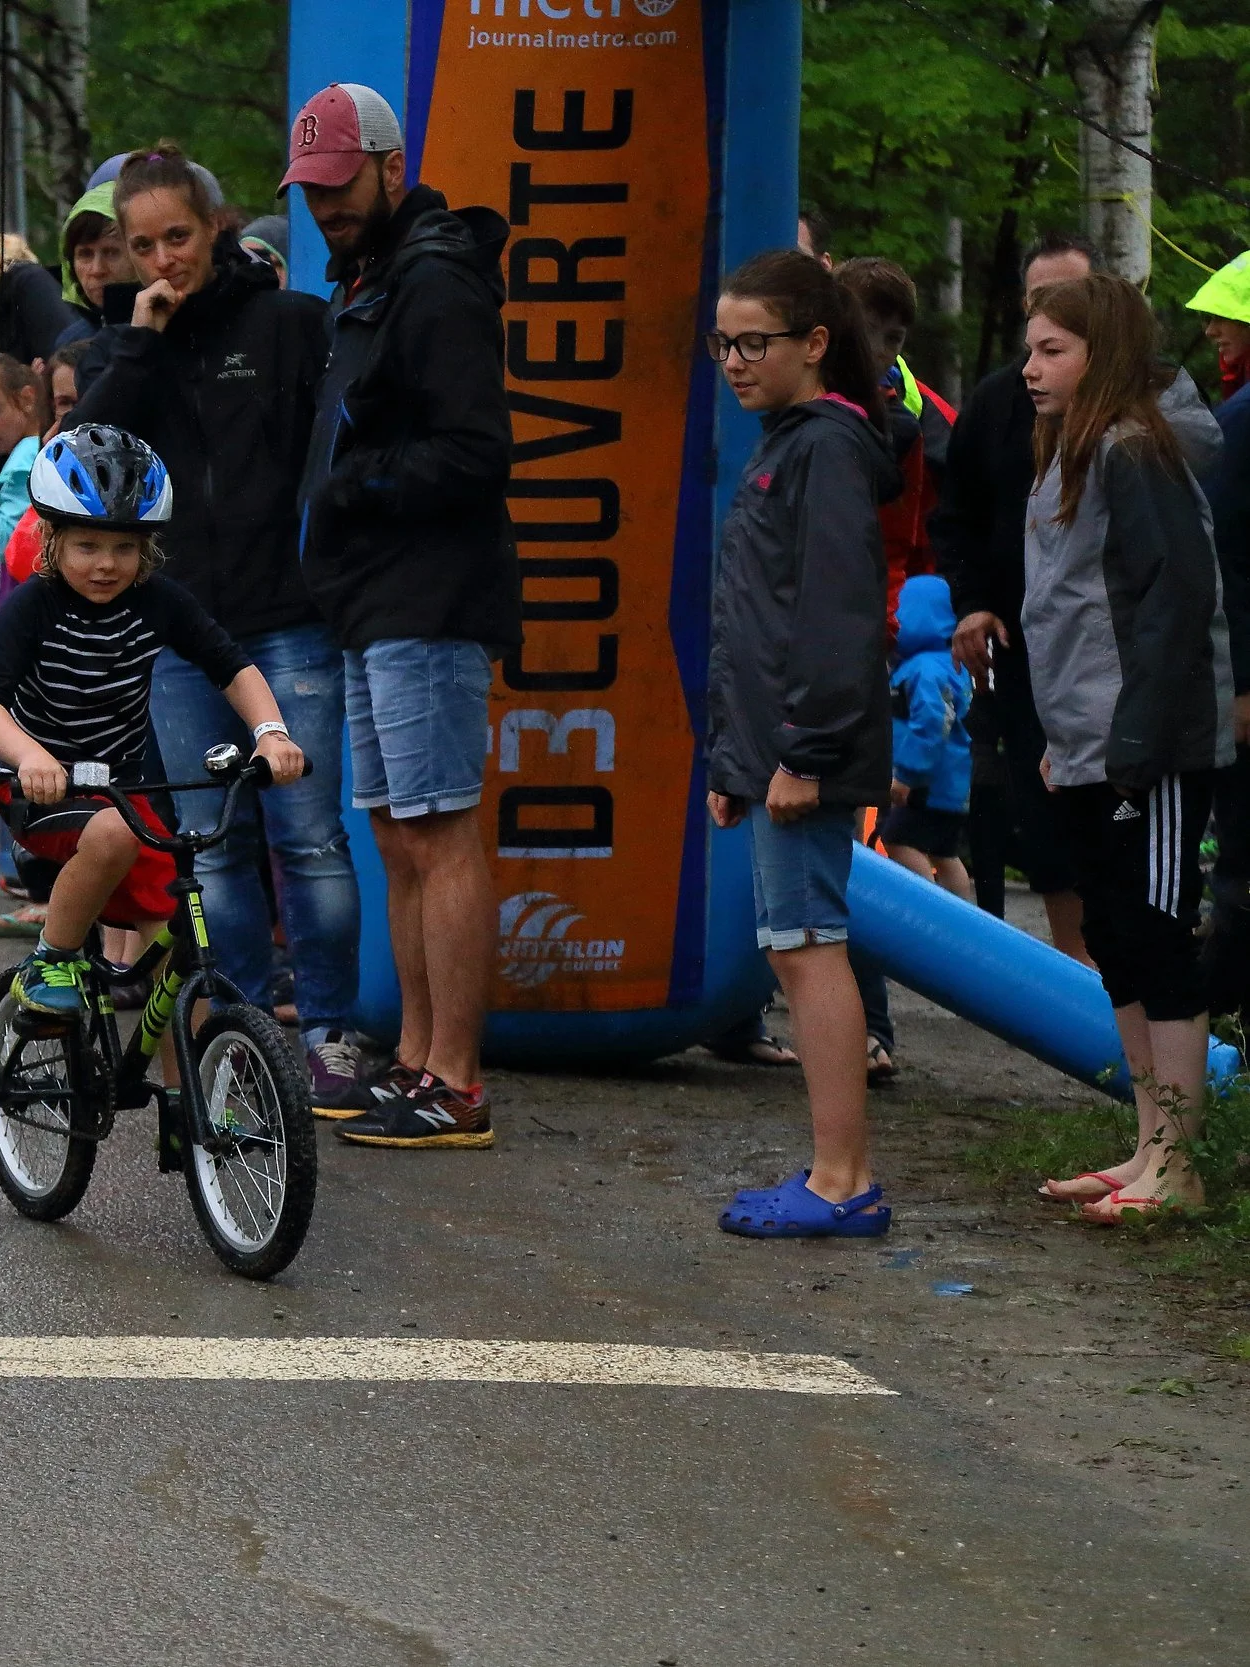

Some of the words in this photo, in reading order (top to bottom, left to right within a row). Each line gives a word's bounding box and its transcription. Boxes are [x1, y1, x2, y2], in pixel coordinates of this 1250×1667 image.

[468, 26, 677, 49] journalmetro.com
[298, 113, 318, 147] B
[414, 1102, 457, 1129] N
